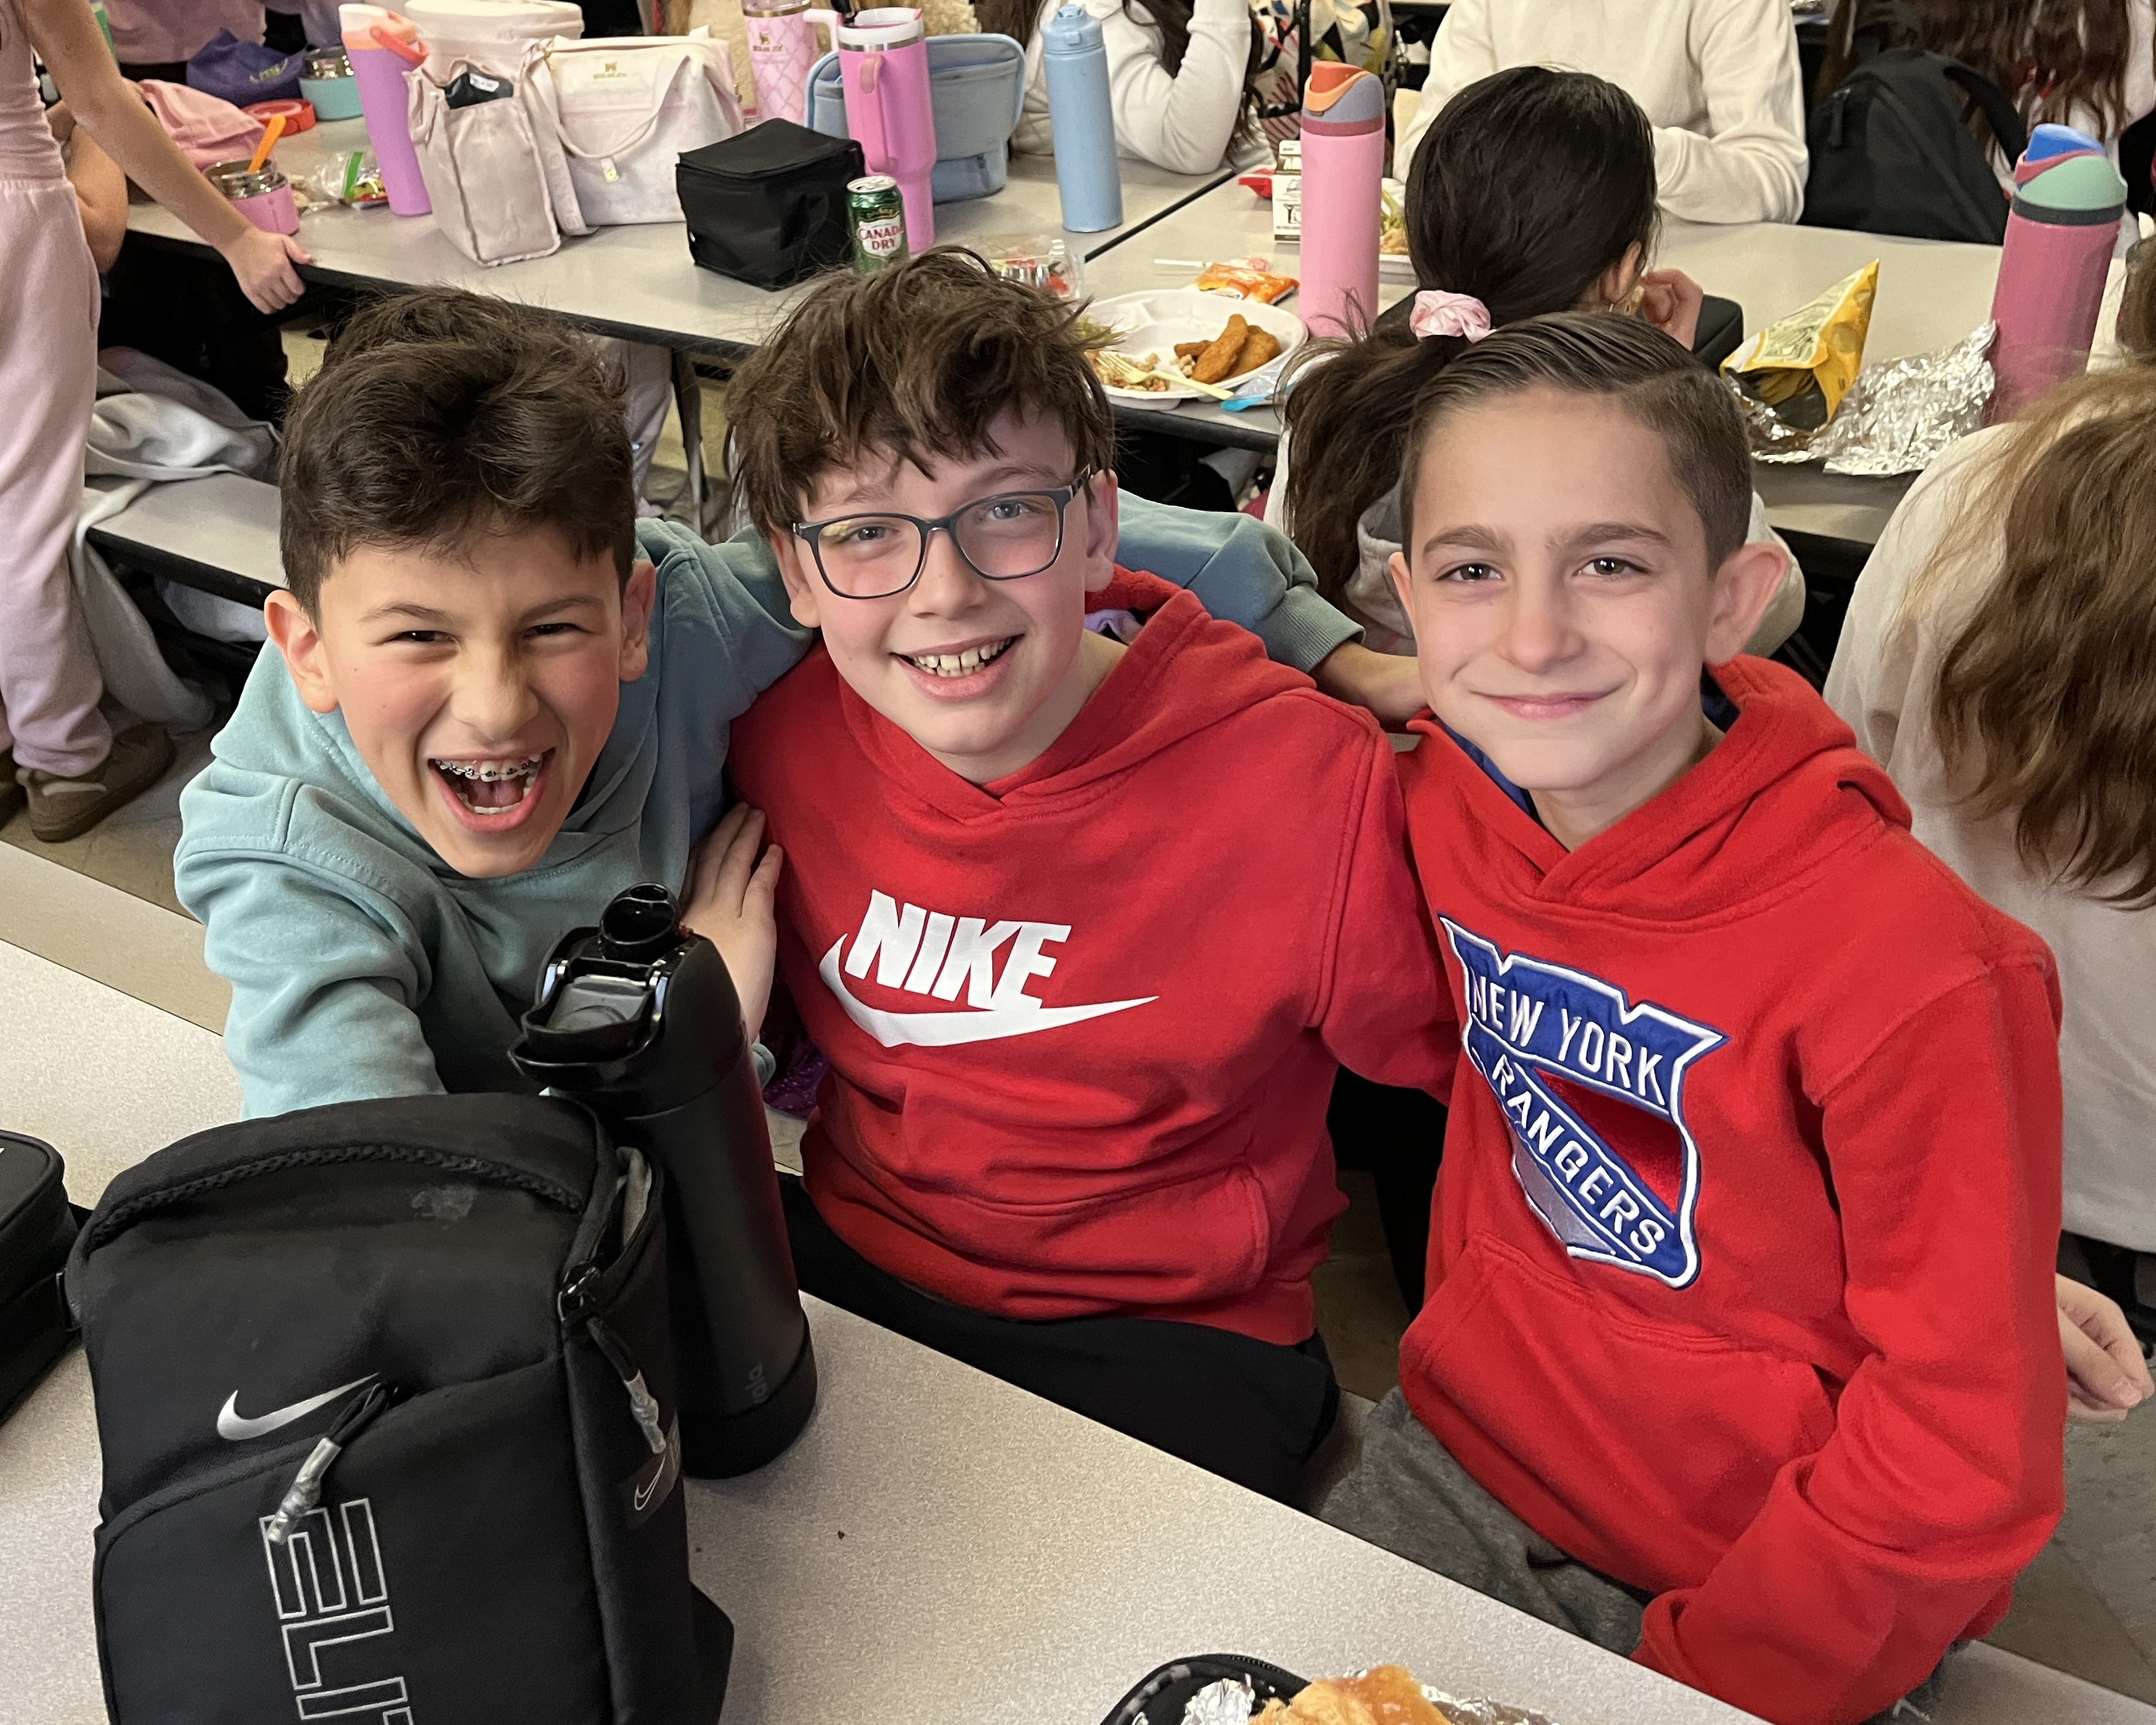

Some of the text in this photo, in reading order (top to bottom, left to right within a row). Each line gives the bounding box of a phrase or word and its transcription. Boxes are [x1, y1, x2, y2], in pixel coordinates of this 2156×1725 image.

[872, 238, 895, 250] DRY
[845, 889, 1072, 1010] NIKE
[1470, 968, 1665, 1106] NEW YORK
[1492, 1054, 1665, 1254] RANGERS
[259, 1497, 415, 1725] ELI
